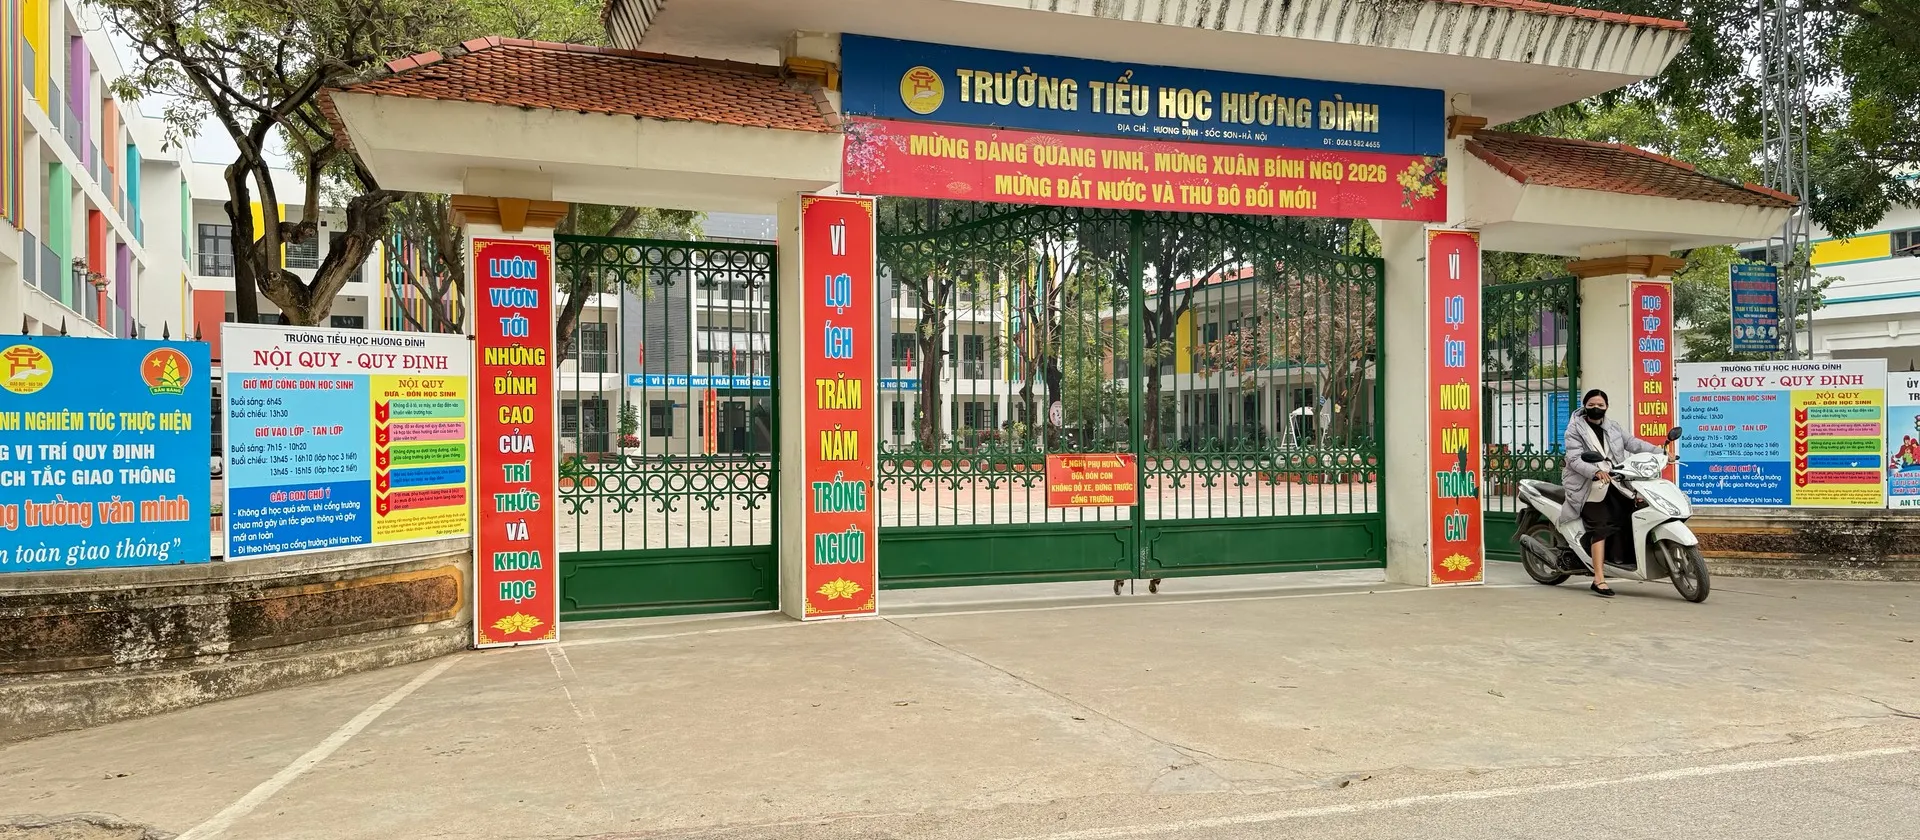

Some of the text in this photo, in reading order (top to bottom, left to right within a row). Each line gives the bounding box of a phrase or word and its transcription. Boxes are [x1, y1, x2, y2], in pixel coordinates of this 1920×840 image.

[957, 66, 1379, 133] TRƯỜNG TIỂU HỌC HƯƠNG ĐÌNH
[1117, 123, 1131, 132] ĐỊA
[1133, 123, 1149, 132] CHỈ:
[1153, 126, 1179, 135] HƯƠNG
[1182, 125, 1199, 137] ĐÌNH
[1204, 127, 1221, 138] SÓC
[1254, 132, 1268, 142] NỘI
[1323, 137, 1334, 145] ĐT:
[1336, 139, 1352, 147] 0243
[910, 132, 1387, 184] MỪNG ĐẢNG QUANG VINH, MỪNG XUÂN BÍNH NGỌ 2026
[995, 171, 1317, 210] MỪNG ĐẤT NƯỚC VÀ THỦ ĐÔ ĐỔI MỚI!
[829, 218, 847, 256] VÌ
[490, 256, 537, 279] LUÔN
[1448, 248, 1460, 280] VÌ
[489, 287, 538, 308] VƯƠN
[825, 273, 852, 315] LỢI
[1641, 296, 1661, 313] HỌC
[1444, 295, 1465, 330] LỢI
[1642, 314, 1660, 334] TẬP
[500, 312, 529, 337] TỚI
[284, 331, 426, 347] TRƯỜNG TIỂU HỌC HƯƠNG ĐÌNH
[825, 320, 853, 359] ÍCH
[1638, 334, 1665, 352] SÁNG
[253, 346, 448, 373] NỘI QUY QUY ĐỊNH
[484, 344, 546, 366] NHỮNG
[1444, 335, 1465, 368] ÍCH
[1642, 359, 1662, 377] TẠO
[1720, 364, 1752, 373] TRƯỜNG
[1754, 363, 1771, 372] TIỂU
[1773, 364, 1789, 373] HỌC
[1822, 363, 1842, 371] ĐÌNH
[318, 379, 334, 391] HỌC
[335, 380, 354, 390] SINH
[399, 377, 445, 390] NỘI QUY
[494, 370, 537, 395] ĐỈNH
[815, 372, 862, 410] TRĂM
[1643, 378, 1663, 394] RÈN
[1697, 374, 1864, 390] NỘI QUY QUY ĐỊNH
[1906, 377, 1919, 389] ỦY
[230, 396, 246, 406] Buổi
[266, 397, 283, 406] 6h45
[1439, 378, 1471, 411] MƯỜI
[1816, 391, 1835, 400] NỘI
[230, 408, 246, 418] Buổi
[269, 409, 289, 418] 13h30
[498, 406, 534, 424] CAO
[1638, 400, 1668, 418] LUYỆN
[25, 408, 84, 431] NGHIÊM
[88, 408, 116, 431] TÚC
[119, 410, 155, 435] THỰC
[159, 409, 192, 435] HIỆN
[1639, 421, 1668, 437] CHĂM
[267, 443, 283, 452] 7h15
[288, 442, 307, 451] 10h20
[499, 428, 535, 454] CỦA
[820, 423, 858, 462] NĂM
[1441, 422, 1470, 455] NĂM
[15, 442, 155, 464] VỊ TRÍ QUY ĐỊNH
[31, 465, 176, 487] TẮC GIAO THÔNG
[502, 460, 532, 483] TRÍ
[1100, 472, 1113, 480] CON
[1436, 462, 1475, 499] TRỒNG
[494, 488, 540, 513] THỨC
[812, 471, 866, 514] TRỒNG
[24, 494, 190, 529] trường văn minh
[505, 518, 530, 542] VÀ
[1444, 509, 1469, 542] CÂY
[15, 541, 62, 564] toàn
[66, 539, 111, 566] giao
[814, 524, 865, 565] NGƯỜI
[493, 551, 542, 571] KHOA
[500, 580, 536, 604] HỌC
